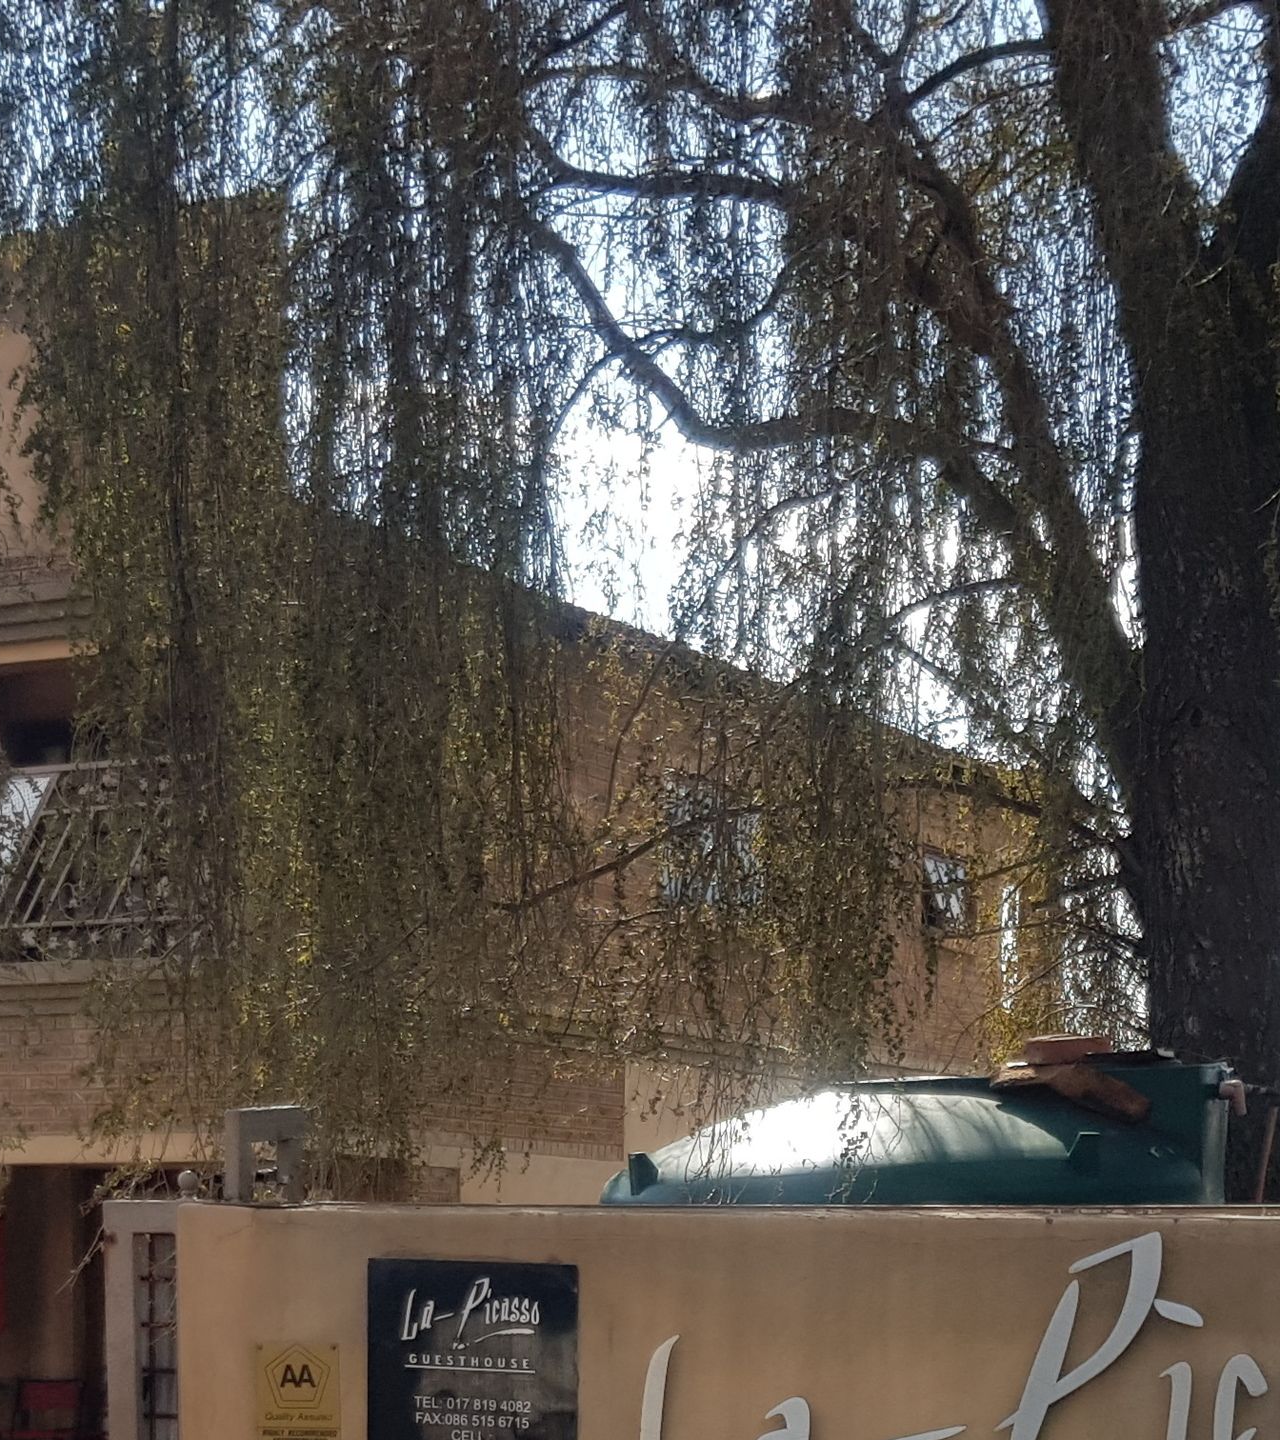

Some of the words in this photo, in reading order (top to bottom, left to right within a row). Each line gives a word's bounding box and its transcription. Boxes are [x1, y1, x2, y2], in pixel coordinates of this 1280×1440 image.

[409, 1353, 530, 1369] GUESTHOUSE
[280, 1364, 316, 1388] AA
[414, 1395, 442, 1409] TEL:
[446, 1397, 469, 1410] 017
[473, 1399, 497, 1412] 819
[500, 1400, 531, 1413] 4082
[472, 1414, 495, 1427] 515
[498, 1416, 530, 1429] 6715
